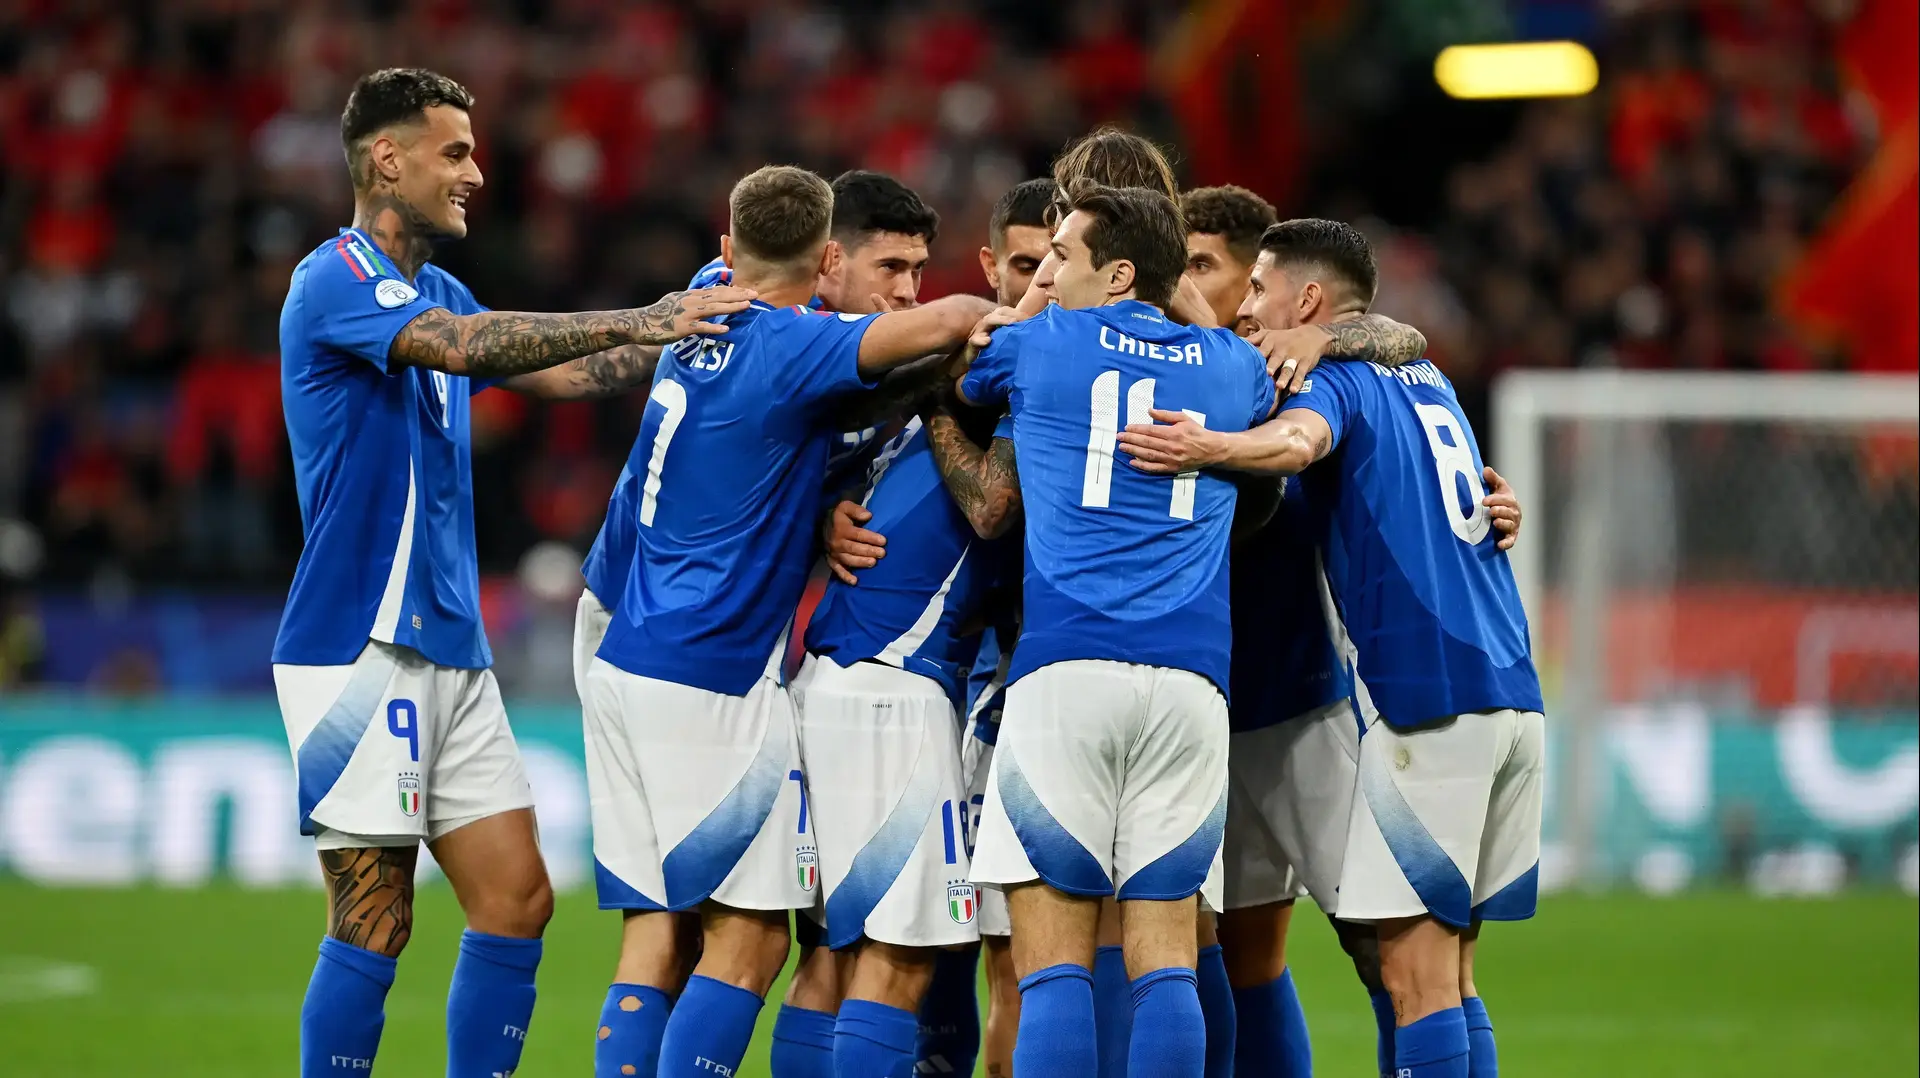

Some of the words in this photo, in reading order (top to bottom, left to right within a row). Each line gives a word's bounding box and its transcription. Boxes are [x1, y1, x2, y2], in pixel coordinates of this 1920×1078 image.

[1099, 325, 1203, 366] CHIESA
[639, 378, 687, 528] 7
[1414, 402, 1492, 546] 8
[387, 698, 419, 762] 9
[400, 781, 418, 789] ITALIA
[788, 769, 807, 834] 7
[949, 888, 972, 897] ITALIA
